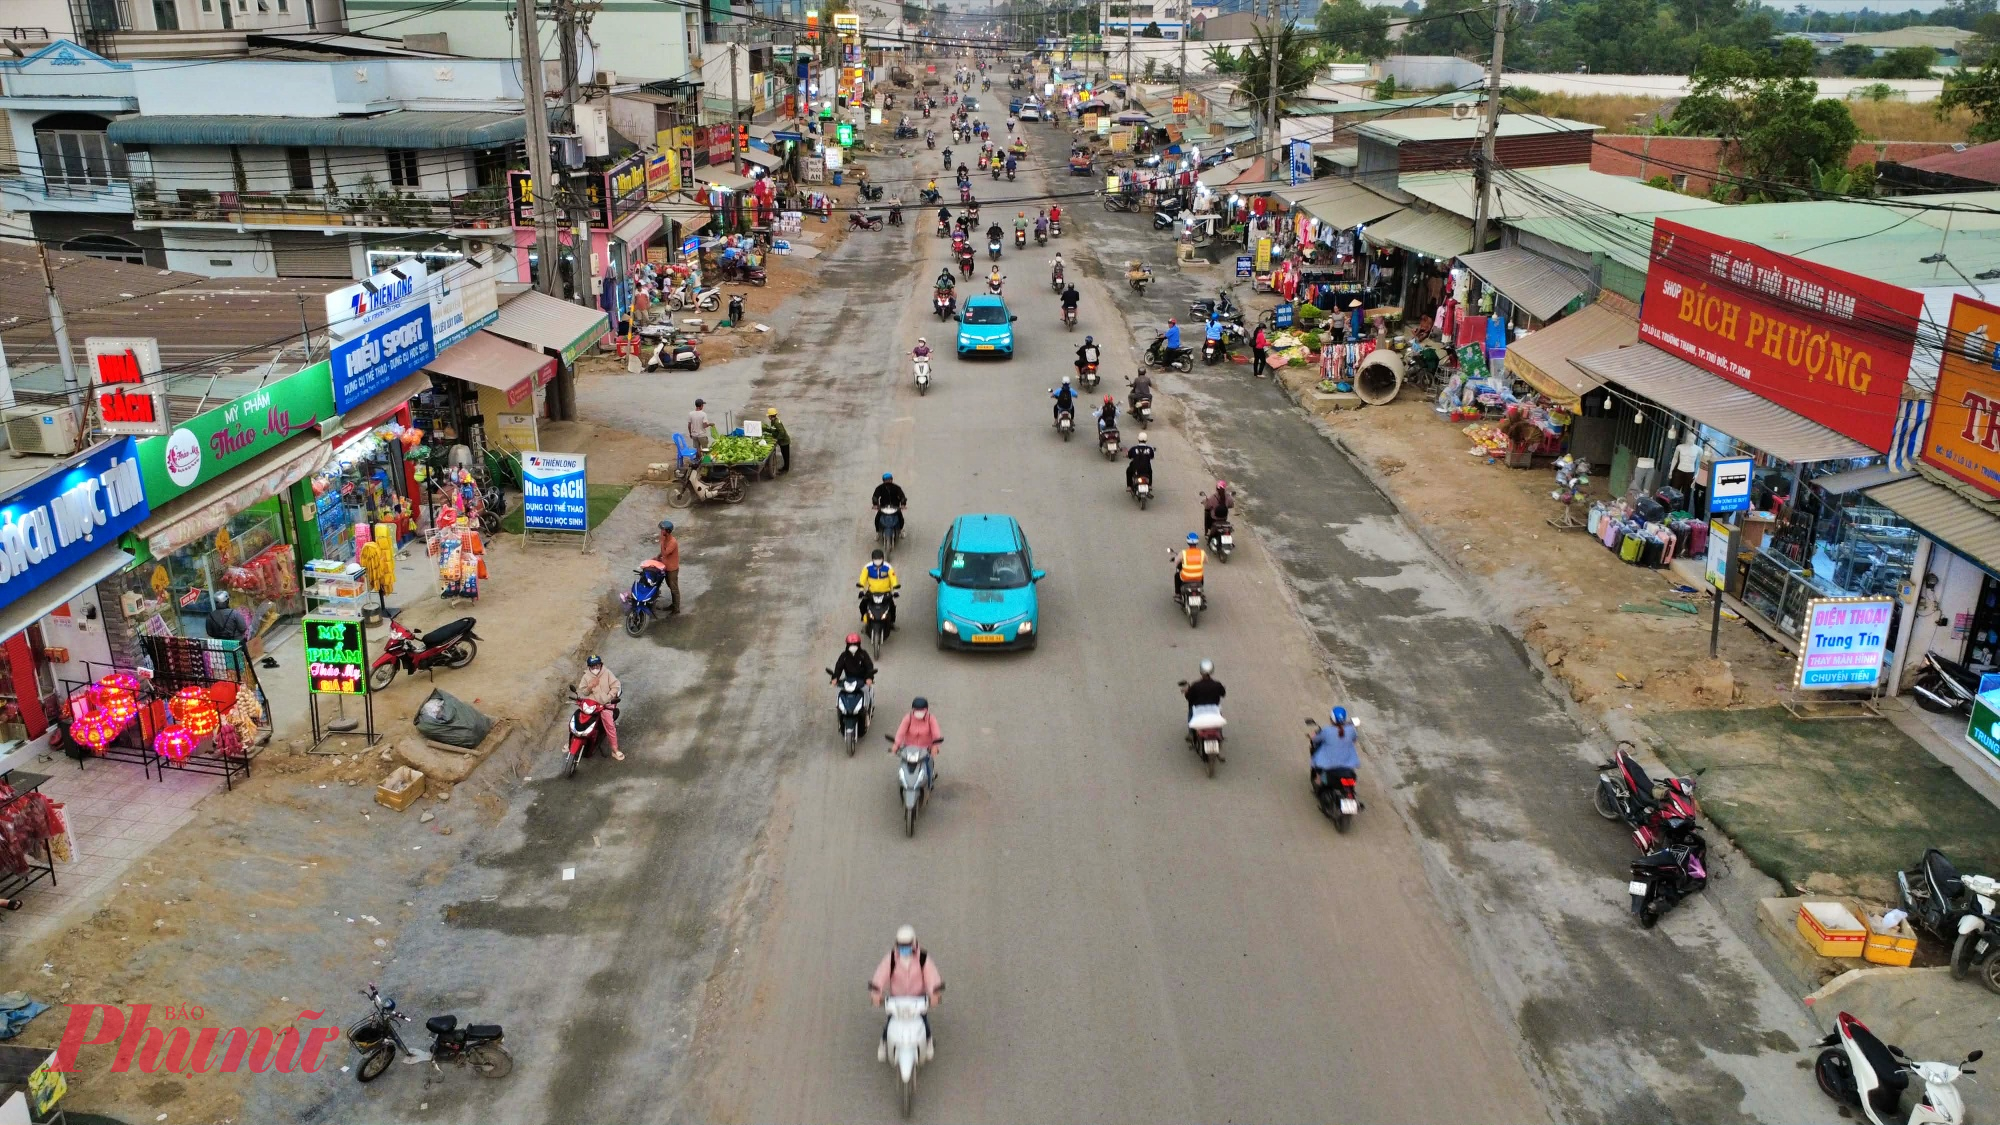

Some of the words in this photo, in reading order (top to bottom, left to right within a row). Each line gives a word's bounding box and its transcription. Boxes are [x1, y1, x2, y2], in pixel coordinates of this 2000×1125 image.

[1662, 279, 1683, 299] SHOP
[1755, 265, 1782, 297] THỜI
[1785, 276, 1825, 311] TRANG
[1825, 289, 1856, 320] NAM
[382, 317, 424, 358] SPORT
[1678, 281, 1742, 342] BÍCH
[1744, 310, 1872, 396] PHƯỢNG
[97, 348, 142, 384] NHÀ
[100, 387, 156, 422] SÁCH
[210, 423, 257, 460] Thảo
[262, 404, 317, 437] My
[100, 457, 144, 518] TÍM
[525, 480, 549, 498] NHÀ
[552, 479, 584, 499] SÁCH
[526, 502, 544, 513] DỤNG
[567, 504, 584, 513] THAO
[526, 515, 544, 526] DỤNG
[554, 516, 568, 527] HỌC
[568, 517, 583, 526] SINH
[1815, 607, 1847, 628] ĐIỆN
[1849, 608, 1888, 627] THOẠI
[308, 641, 360, 664] PHẨM
[1815, 633, 1853, 650] Trung
[1858, 632, 1880, 646] Tín
[1810, 656, 1832, 666] THAY
[1833, 654, 1852, 664] MÀN
[1854, 653, 1877, 664] HÌNH
[1811, 670, 1848, 682] CHUYỂN
[1850, 669, 1870, 680] TIỀN
[1974, 727, 2000, 755] TRUNG
